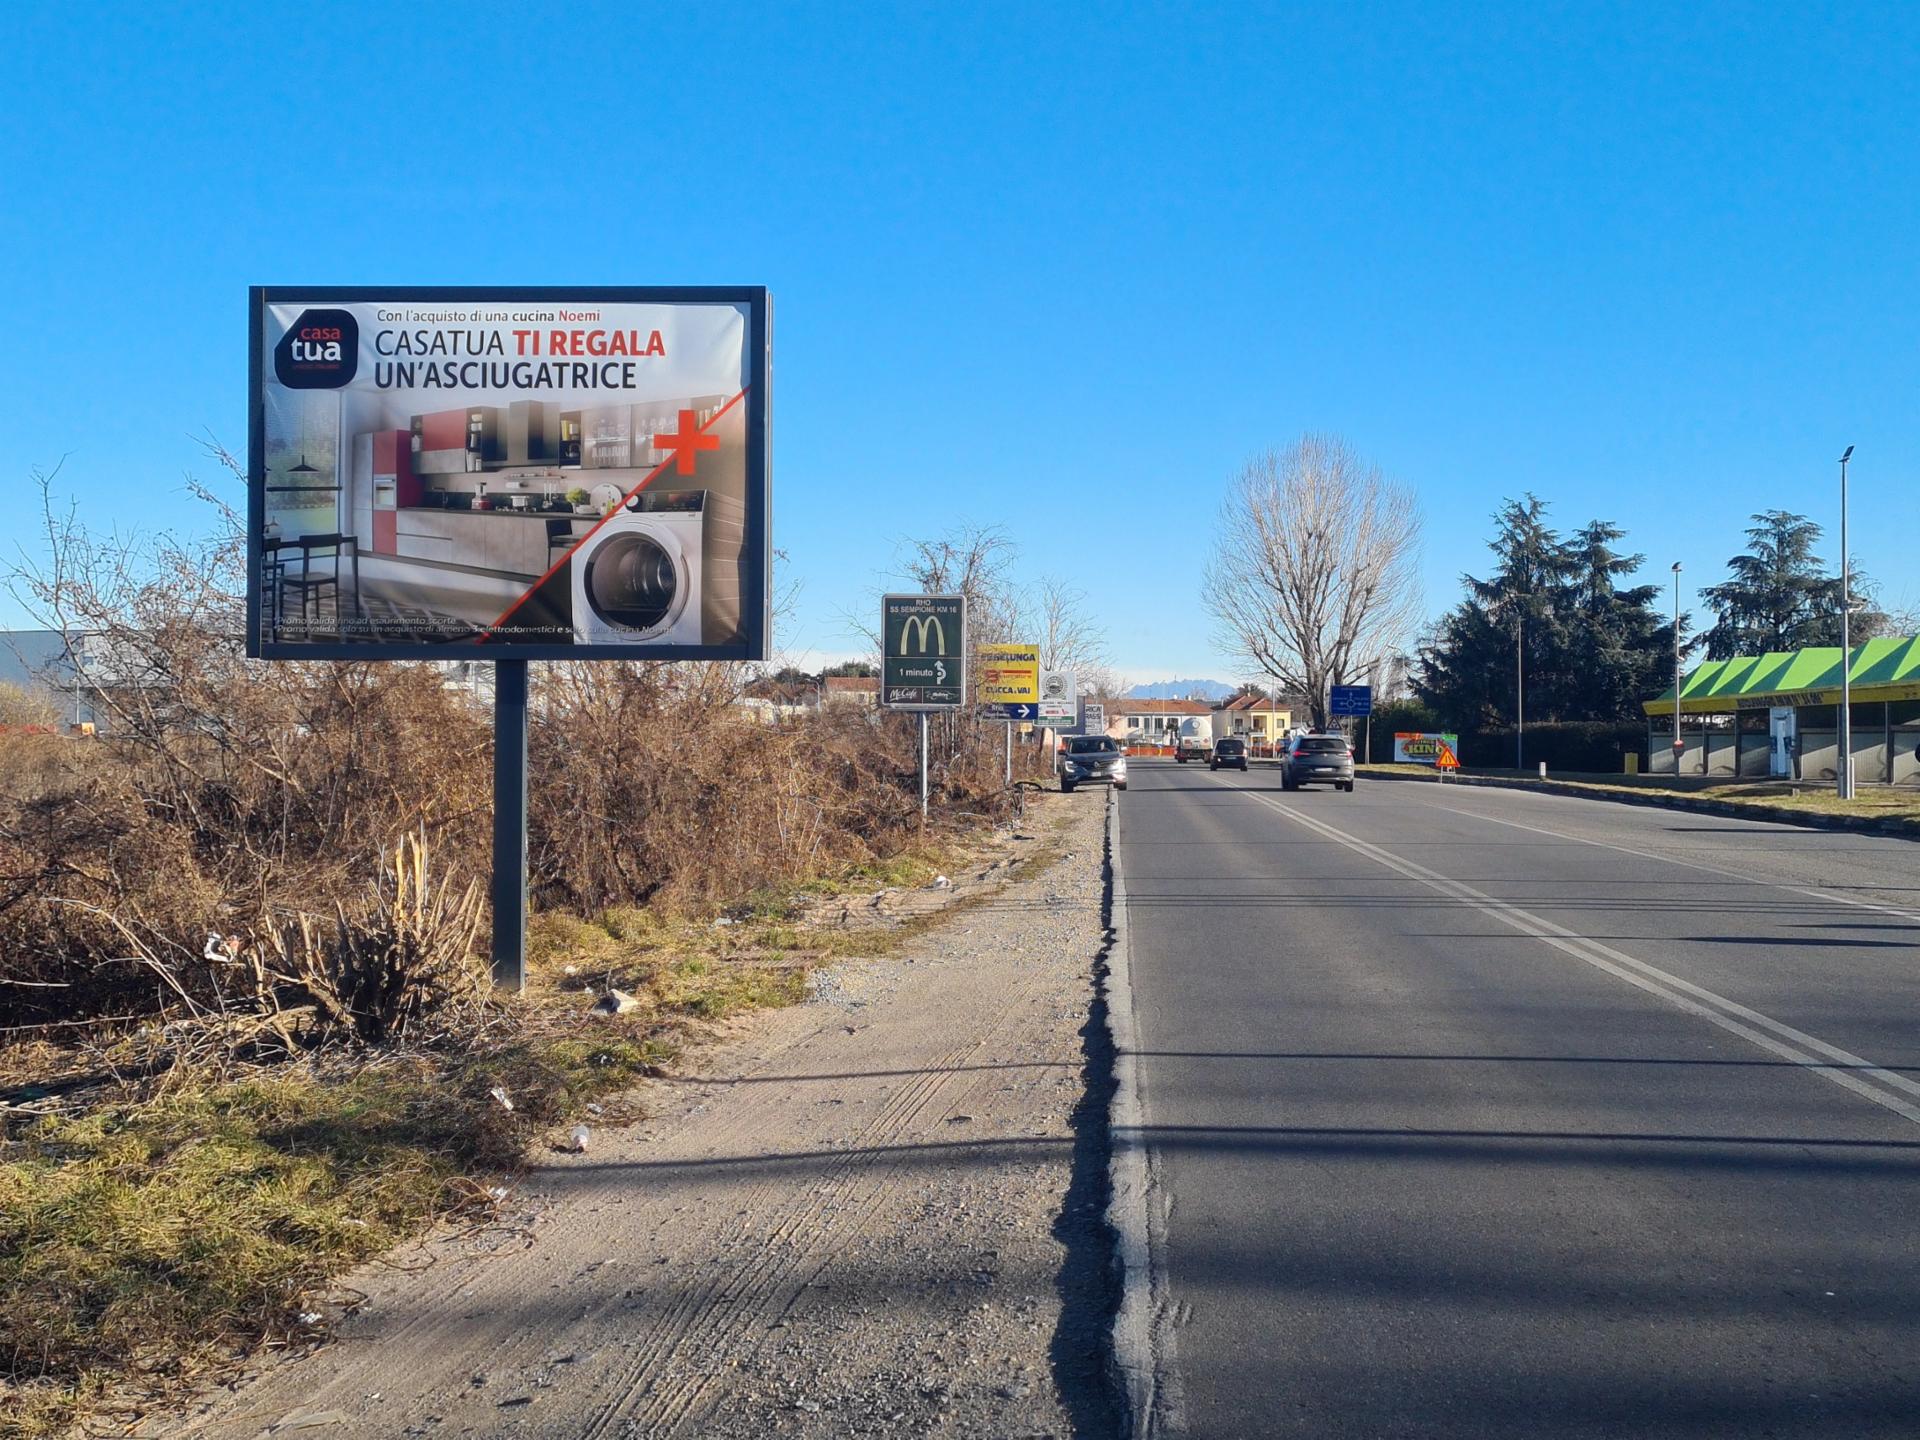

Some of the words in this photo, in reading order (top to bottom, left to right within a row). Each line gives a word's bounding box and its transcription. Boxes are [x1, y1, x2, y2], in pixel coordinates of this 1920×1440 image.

[377, 309, 402, 322] Con
[406, 309, 467, 324] l'acquisto
[470, 309, 482, 322] di
[485, 312, 509, 322] una
[512, 310, 555, 322] cucina
[558, 310, 601, 322] Noemi
[300, 327, 342, 340] casa
[375, 329, 505, 357] CASATUA
[512, 329, 541, 357] TI
[550, 329, 666, 357] REGALA
[291, 337, 342, 362] tua
[374, 361, 637, 390] UN'ASCIUGATRICE
[899, 668, 904, 677] 1
[905, 668, 934, 677] minuto
